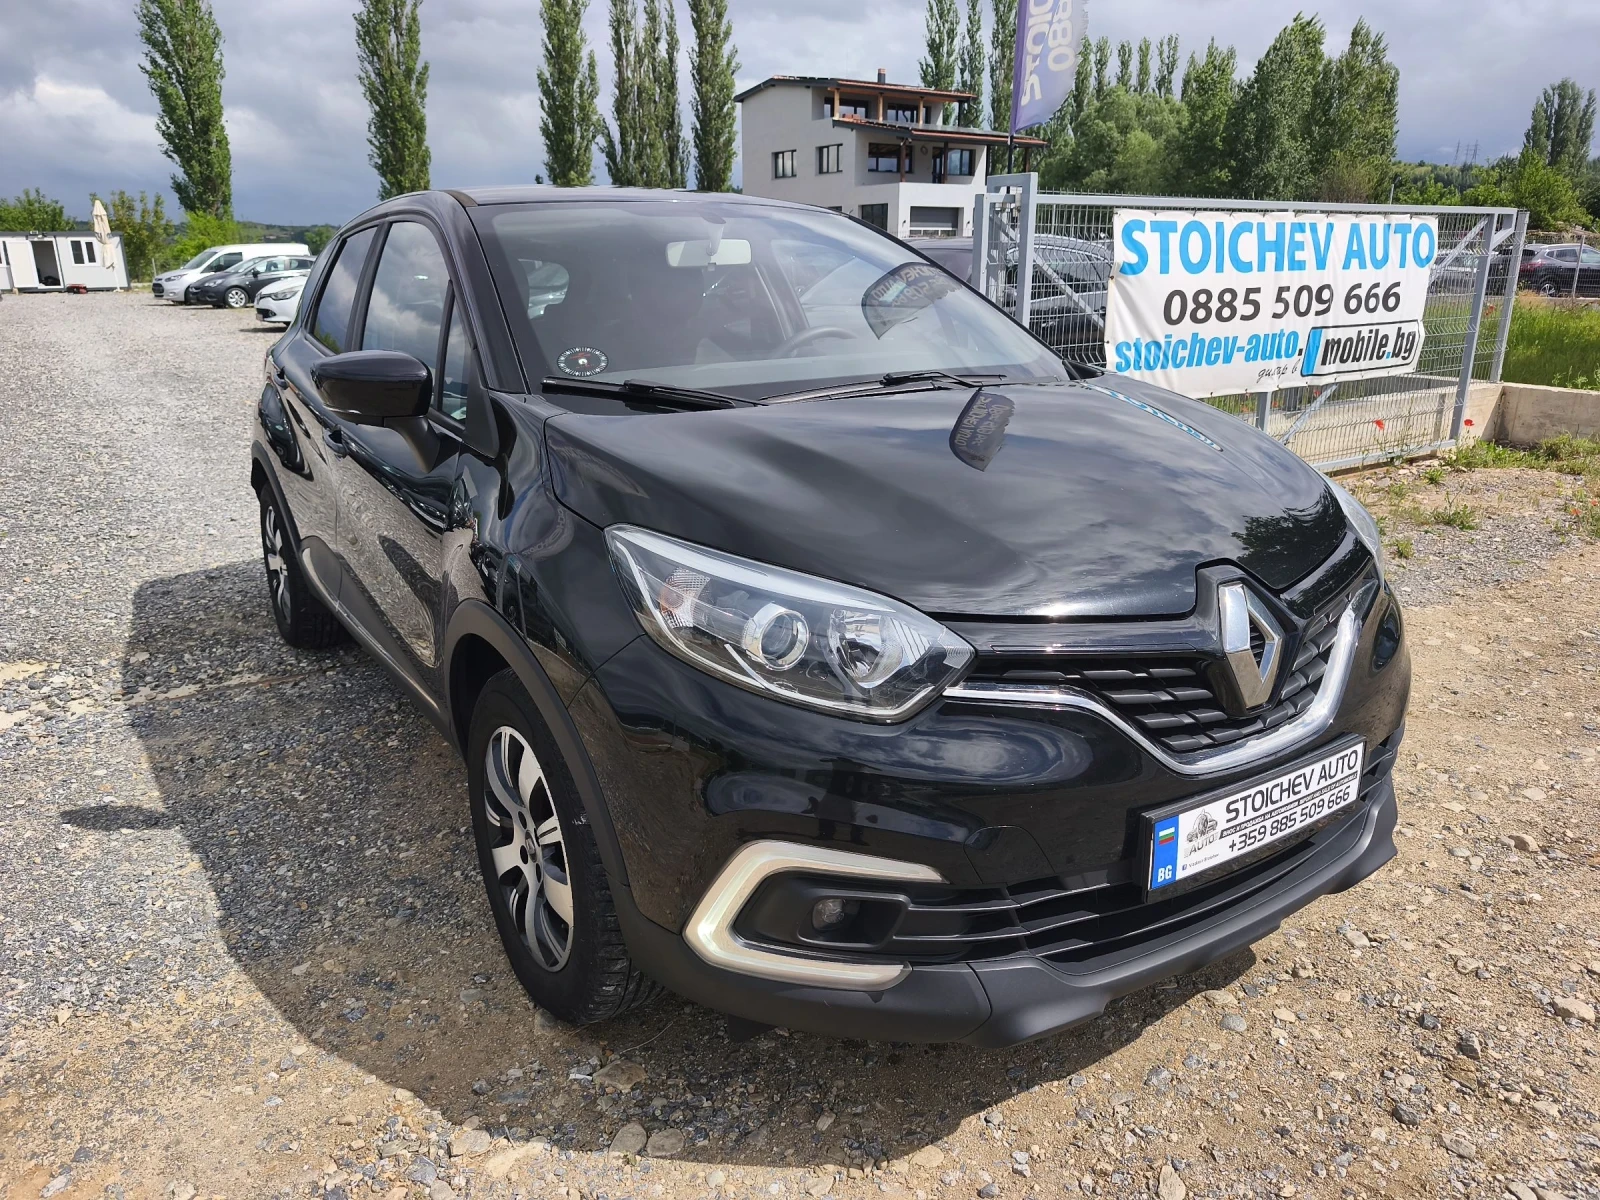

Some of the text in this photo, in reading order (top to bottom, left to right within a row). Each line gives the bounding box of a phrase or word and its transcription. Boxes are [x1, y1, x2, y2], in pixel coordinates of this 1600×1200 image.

[1119, 218, 1436, 276] STOICHEV AUTO
[1163, 281, 1401, 326] 0885 509 666
[1320, 326, 1417, 367] mobile.bg
[1226, 749, 1358, 824] STOICHEV AUTO
[1228, 785, 1351, 852] +359 885 509 666
[1189, 834, 1215, 857] AUTO
[1158, 865, 1173, 883] BG
